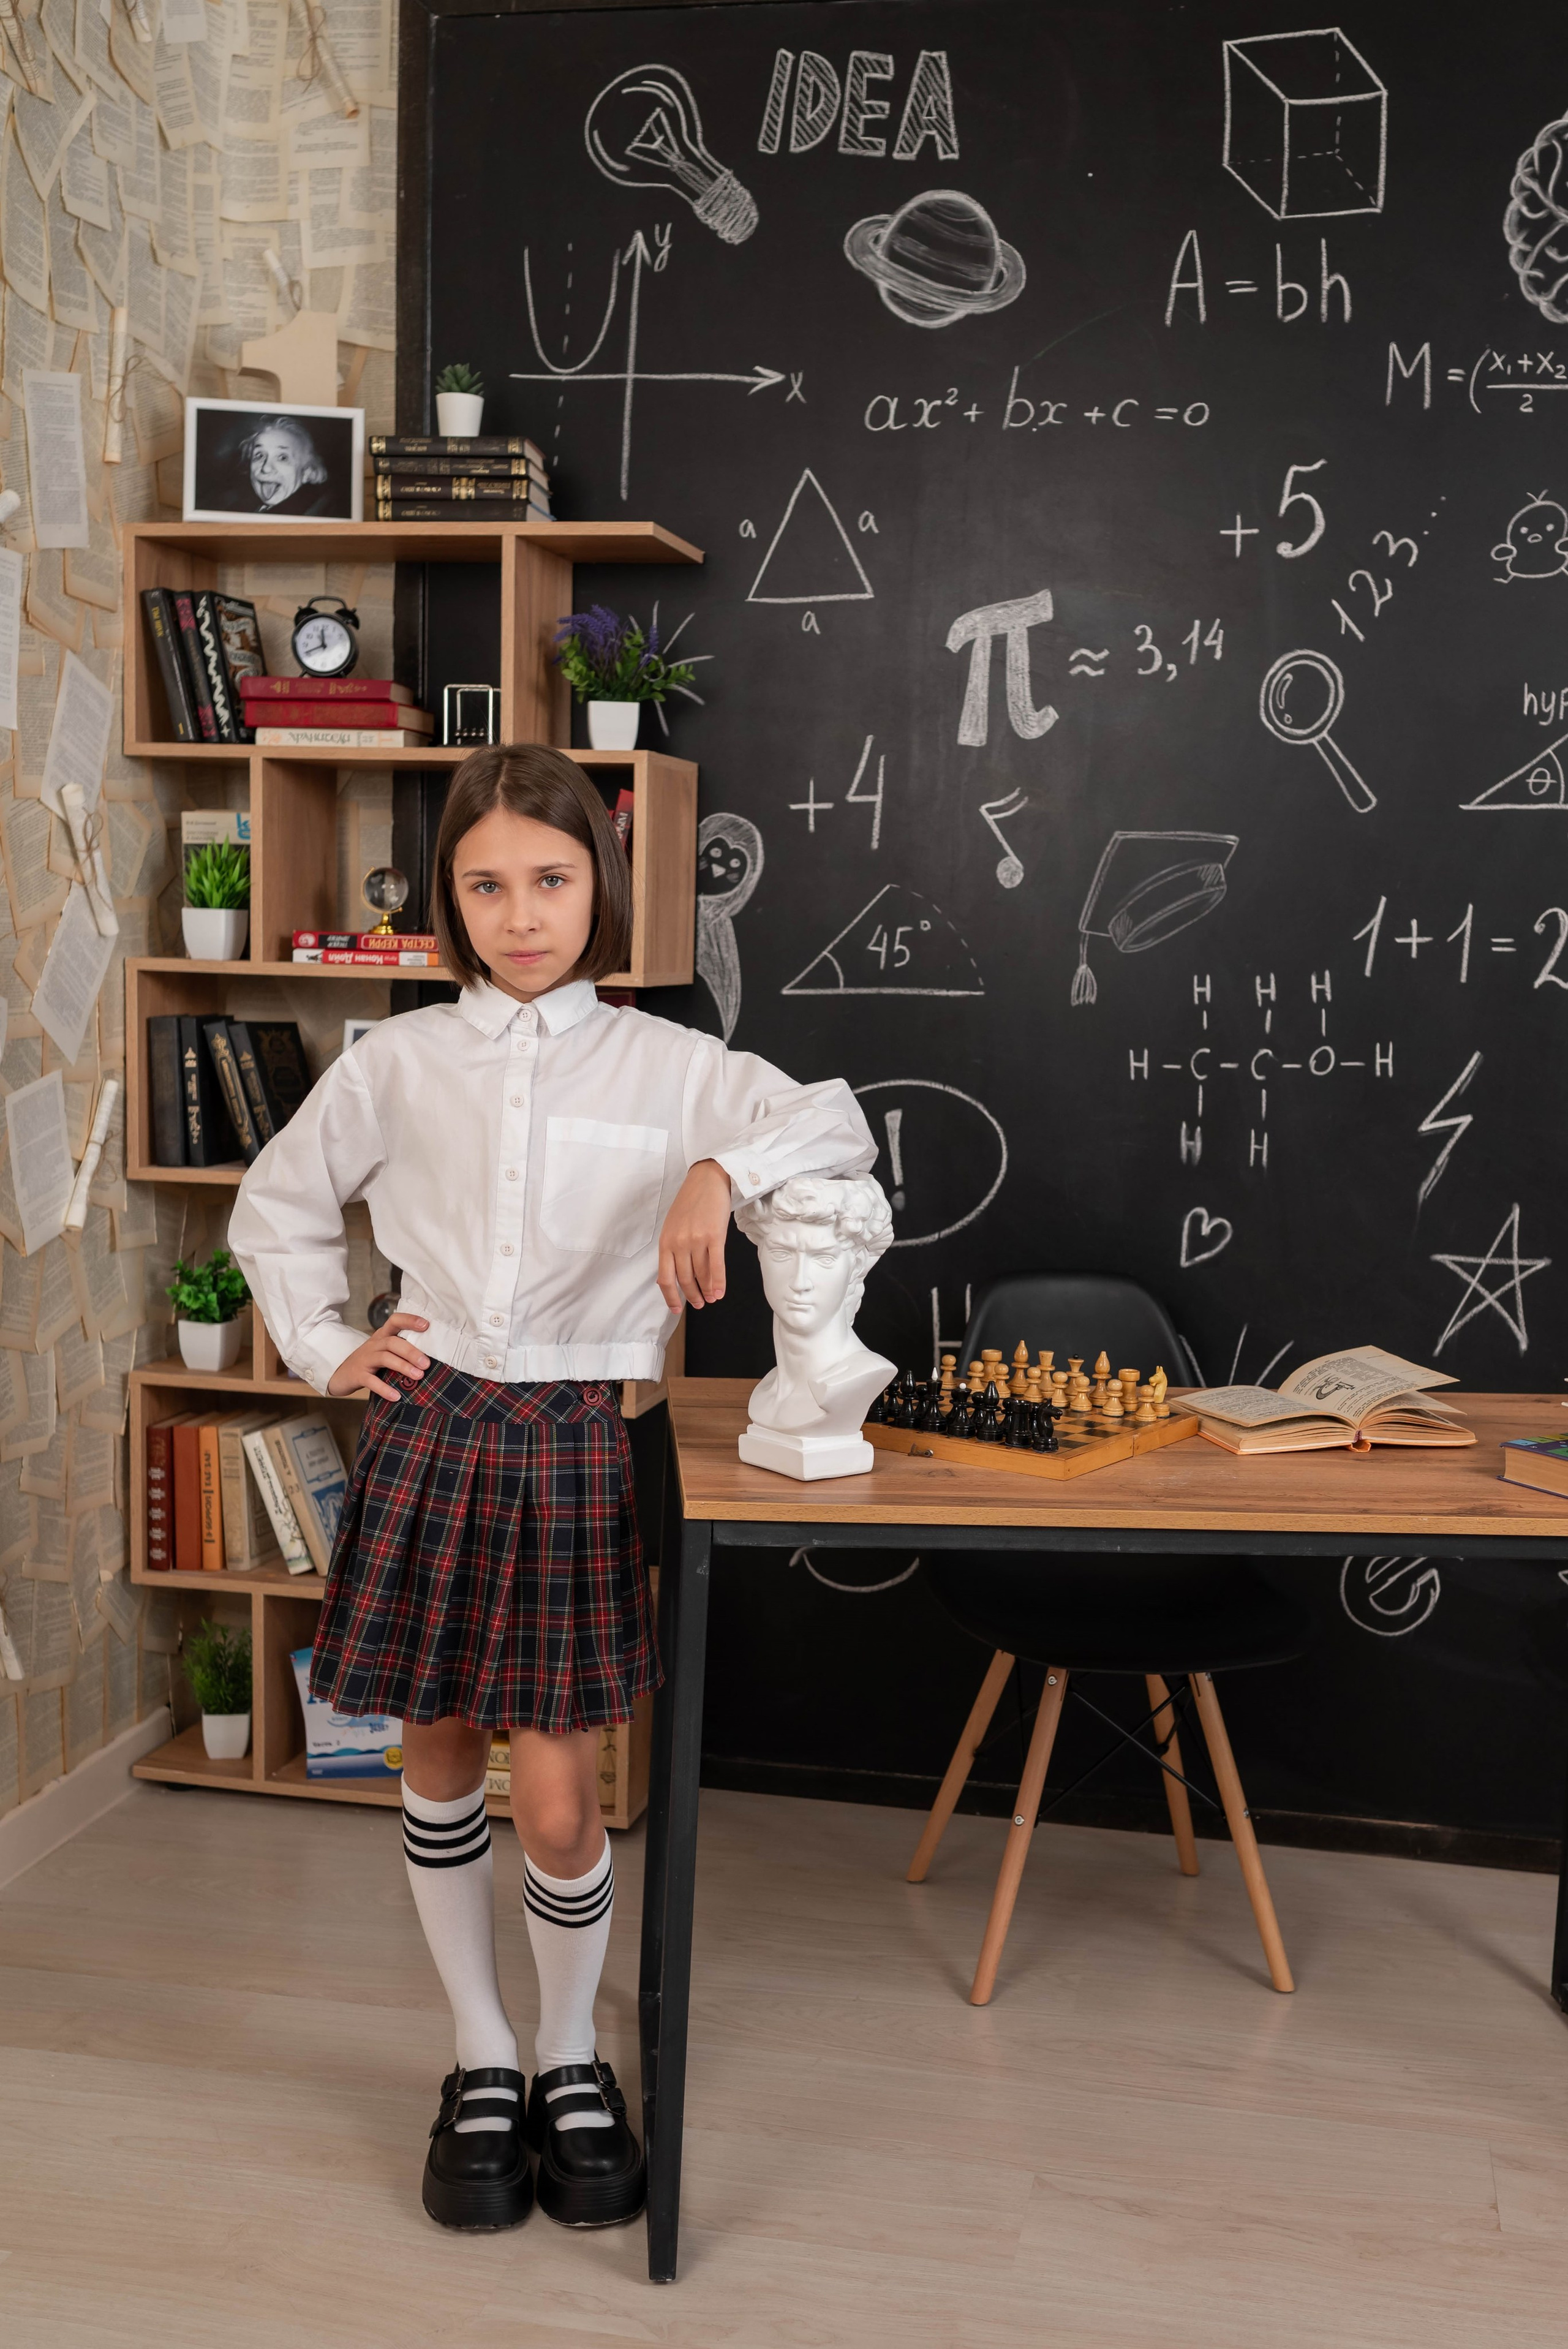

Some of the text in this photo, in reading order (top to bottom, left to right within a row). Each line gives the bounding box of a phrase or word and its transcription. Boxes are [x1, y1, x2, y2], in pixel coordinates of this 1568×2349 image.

[757, 48, 960, 160] IDEA
[1165, 230, 1207, 327] A
[739, 519, 757, 538] a
[858, 510, 880, 534] a
[801, 611, 821, 635] a
[1134, 618, 1224, 682] 3,14
[368, 938, 435, 949] СЕСТРА КЕРРИ
